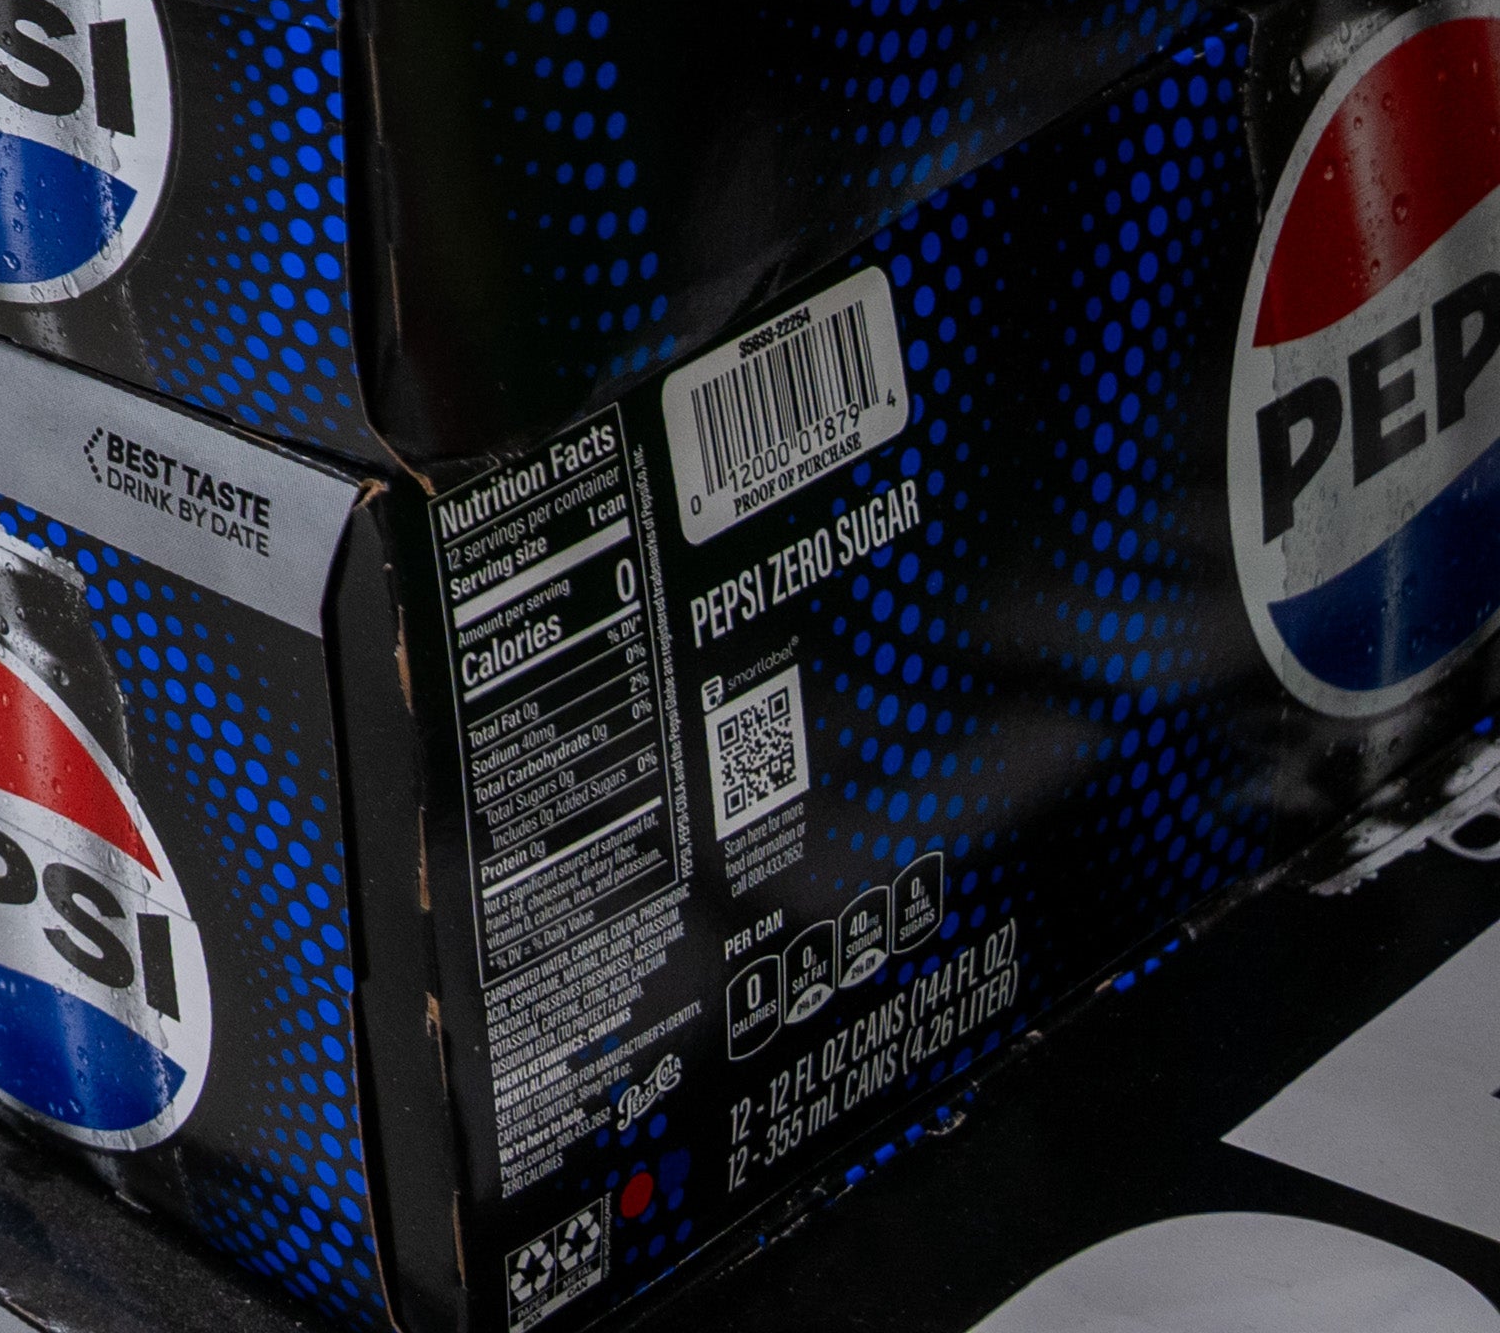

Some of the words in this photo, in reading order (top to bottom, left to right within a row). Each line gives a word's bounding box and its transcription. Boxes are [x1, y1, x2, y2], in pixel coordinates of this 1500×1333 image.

[728, 442, 790, 492] 12000
[799, 402, 860, 455] 01879
[1255, 271, 1500, 546] PEP
[105, 434, 175, 488] BEST
[181, 464, 271, 528] TASTE
[105, 472, 172, 521] DRINK
[178, 495, 212, 530] BY
[212, 511, 271, 557] DATE
[438, 460, 547, 539] Nutrition
[550, 424, 616, 480] Facts
[734, 483, 777, 517] PROOF
[779, 469, 795, 492] OF
[797, 432, 862, 481] PURCHASE
[446, 547, 462, 572] 12
[465, 517, 525, 558] servings
[527, 502, 551, 535] per
[554, 466, 620, 515] container
[450, 554, 514, 601] Serving
[515, 536, 548, 565] size
[587, 507, 596, 527] 1
[598, 493, 627, 523] can
[615, 558, 636, 603] 0
[690, 563, 766, 649] PEPSI
[767, 527, 833, 606] ZERO
[836, 479, 920, 566] SUGAR
[458, 614, 504, 650] Amount
[506, 604, 526, 628] per
[526, 579, 571, 621] serving
[461, 614, 563, 687] Calories
[468, 722, 500, 749] Total
[501, 712, 522, 736] Fat
[523, 702, 539, 722] 0g
[472, 744, 521, 779] Sodium
[522, 723, 556, 751] 40mg
[474, 780, 505, 805] Total
[507, 731, 591, 789] Carbohydrate
[592, 723, 608, 745] 0g
[725, 926, 753, 961] PER
[755, 908, 783, 942] CAN
[730, 1096, 750, 1145] 12
[769, 1070, 790, 1119] 12
[795, 1052, 816, 1101] FL
[822, 1029, 850, 1082] OZ
[852, 992, 906, 1062] CANS
[910, 962, 953, 1027] (144
[956, 947, 978, 994] FL
[984, 917, 1017, 976] OZ)
[728, 1145, 750, 1193] 12
[764, 1105, 804, 1167] 355
[807, 1082, 839, 1137] mL
[844, 1042, 899, 1111] CANS
[903, 1006, 954, 1075] (4.26
[958, 960, 1019, 1037] LITER)
